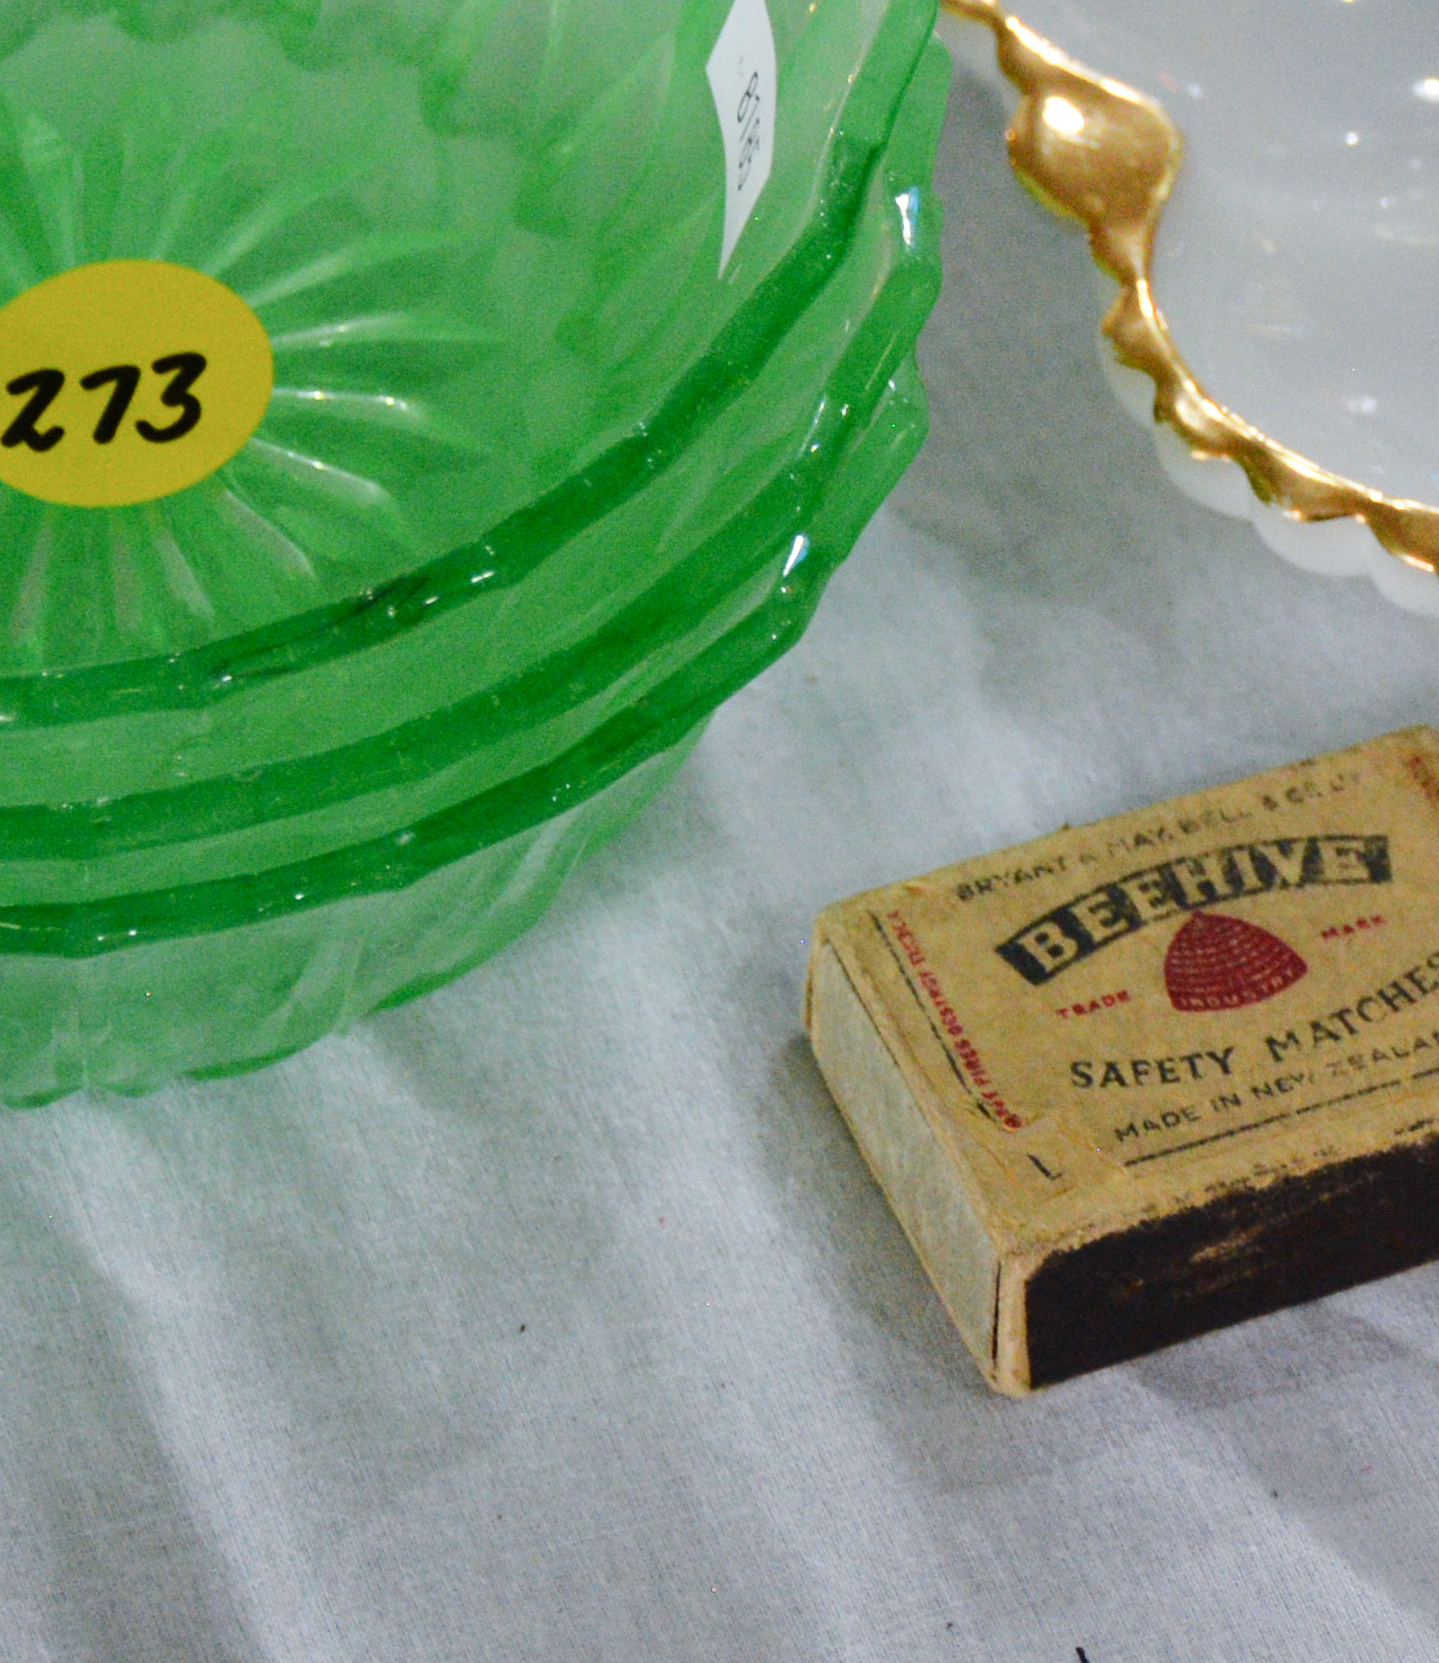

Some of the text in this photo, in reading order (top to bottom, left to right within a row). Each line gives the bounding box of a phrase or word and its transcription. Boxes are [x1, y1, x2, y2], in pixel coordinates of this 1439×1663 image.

[0, 351, 207, 452] 273
[957, 855, 1069, 902] BRYANT
[1013, 837, 1374, 974] BEEHIVE
[1056, 915, 1387, 1019] TRADE MARK
[1179, 968, 1294, 1007] INDUSTRY
[954, 1038, 991, 1088] FIRES
[1069, 1046, 1234, 1089] SAFETY
[1113, 1105, 1201, 1142] MADE
[1211, 1091, 1241, 1114] IN
[1251, 1071, 1316, 1102] NEW
